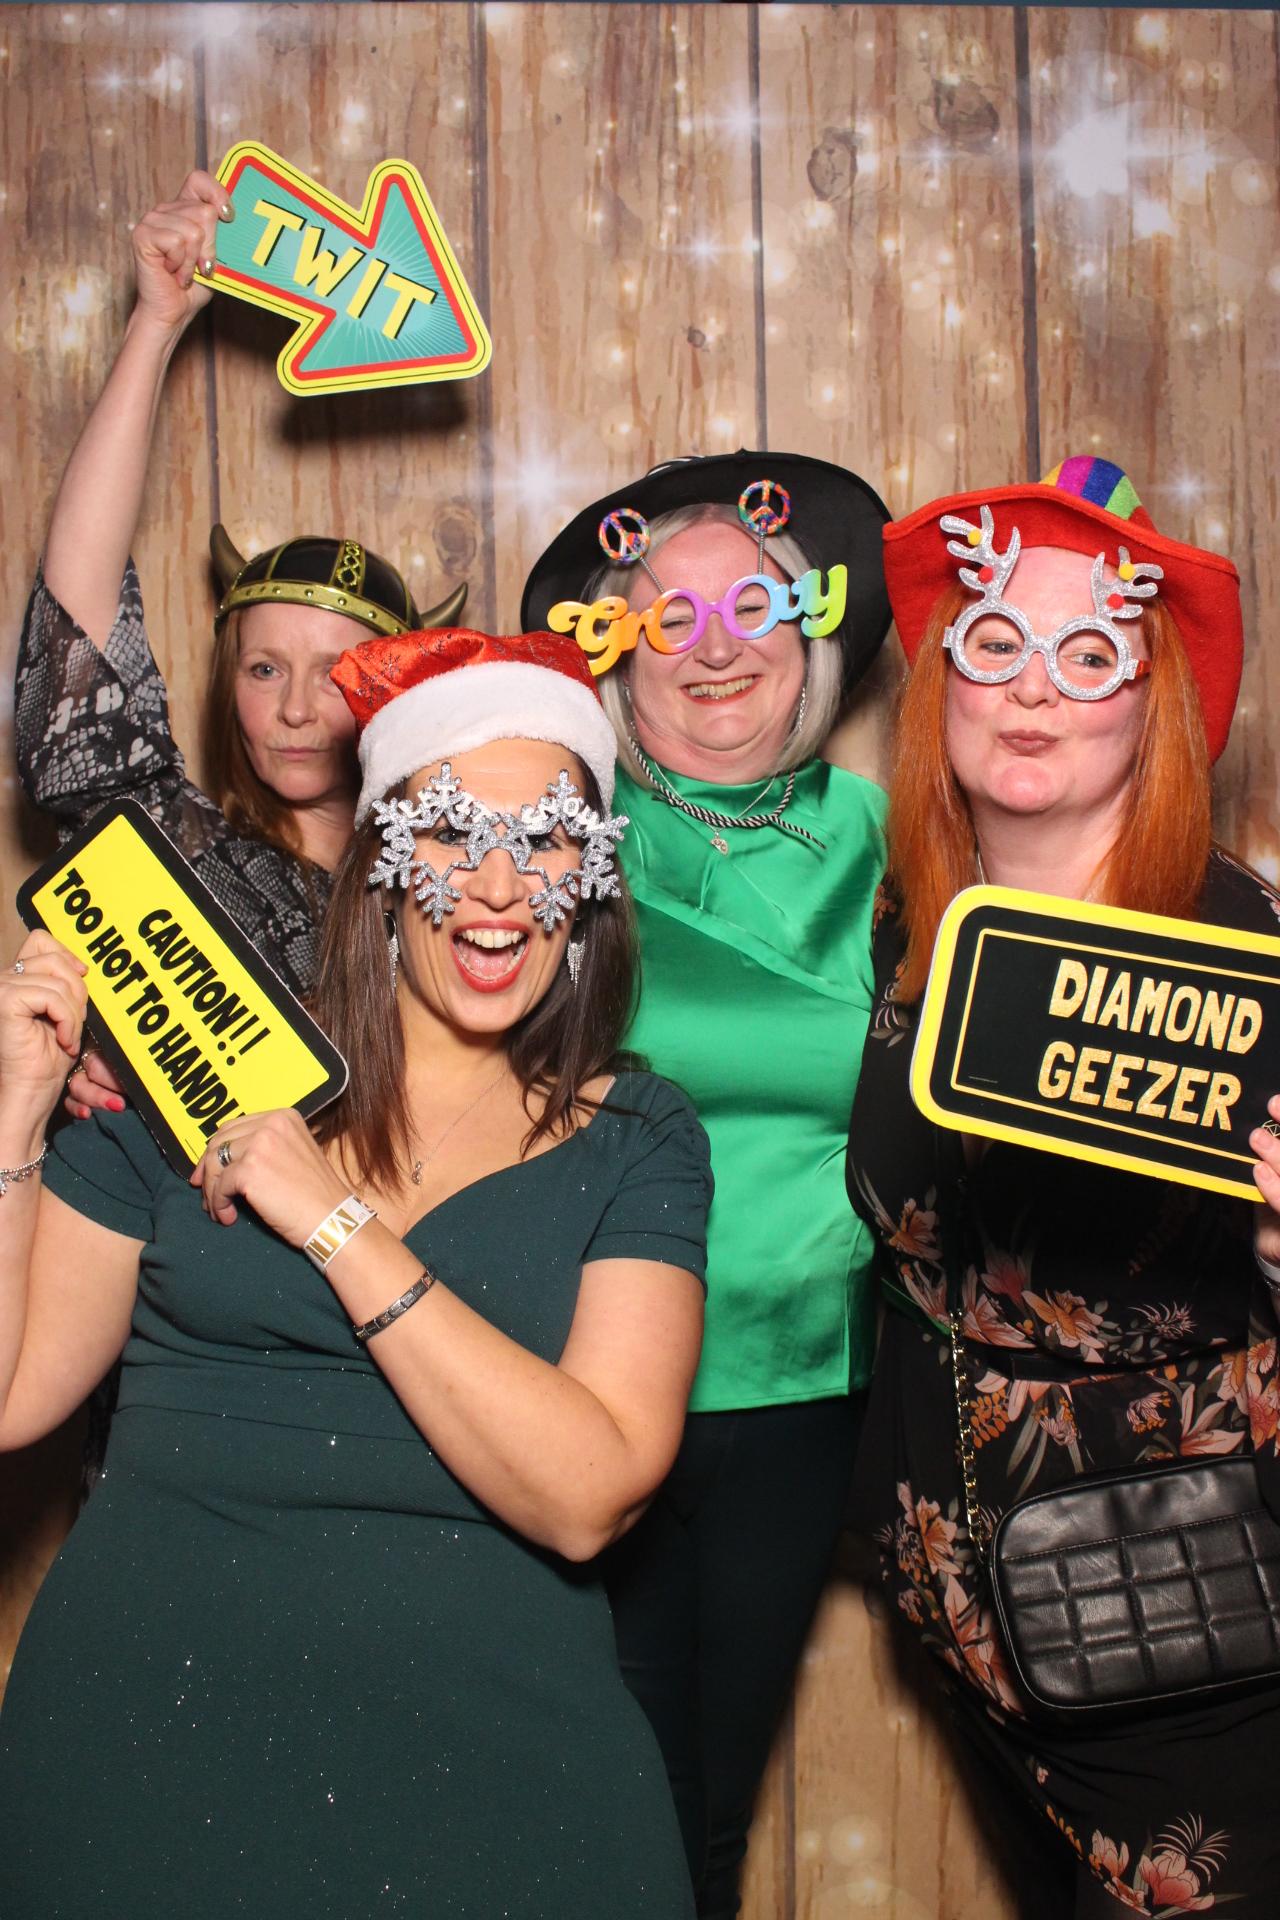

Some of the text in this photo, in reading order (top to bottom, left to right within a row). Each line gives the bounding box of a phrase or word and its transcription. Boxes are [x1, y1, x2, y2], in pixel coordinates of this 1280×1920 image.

[252, 199, 438, 340] TWIT
[398, 784, 606, 831] LET IT SNOW
[52, 868, 246, 1145] TOO HOT TO HANDL
[138, 909, 271, 1066] CAUTION!!
[1048, 958, 1263, 1055] DIAMOND
[1037, 1040, 1242, 1131] GEEZER
